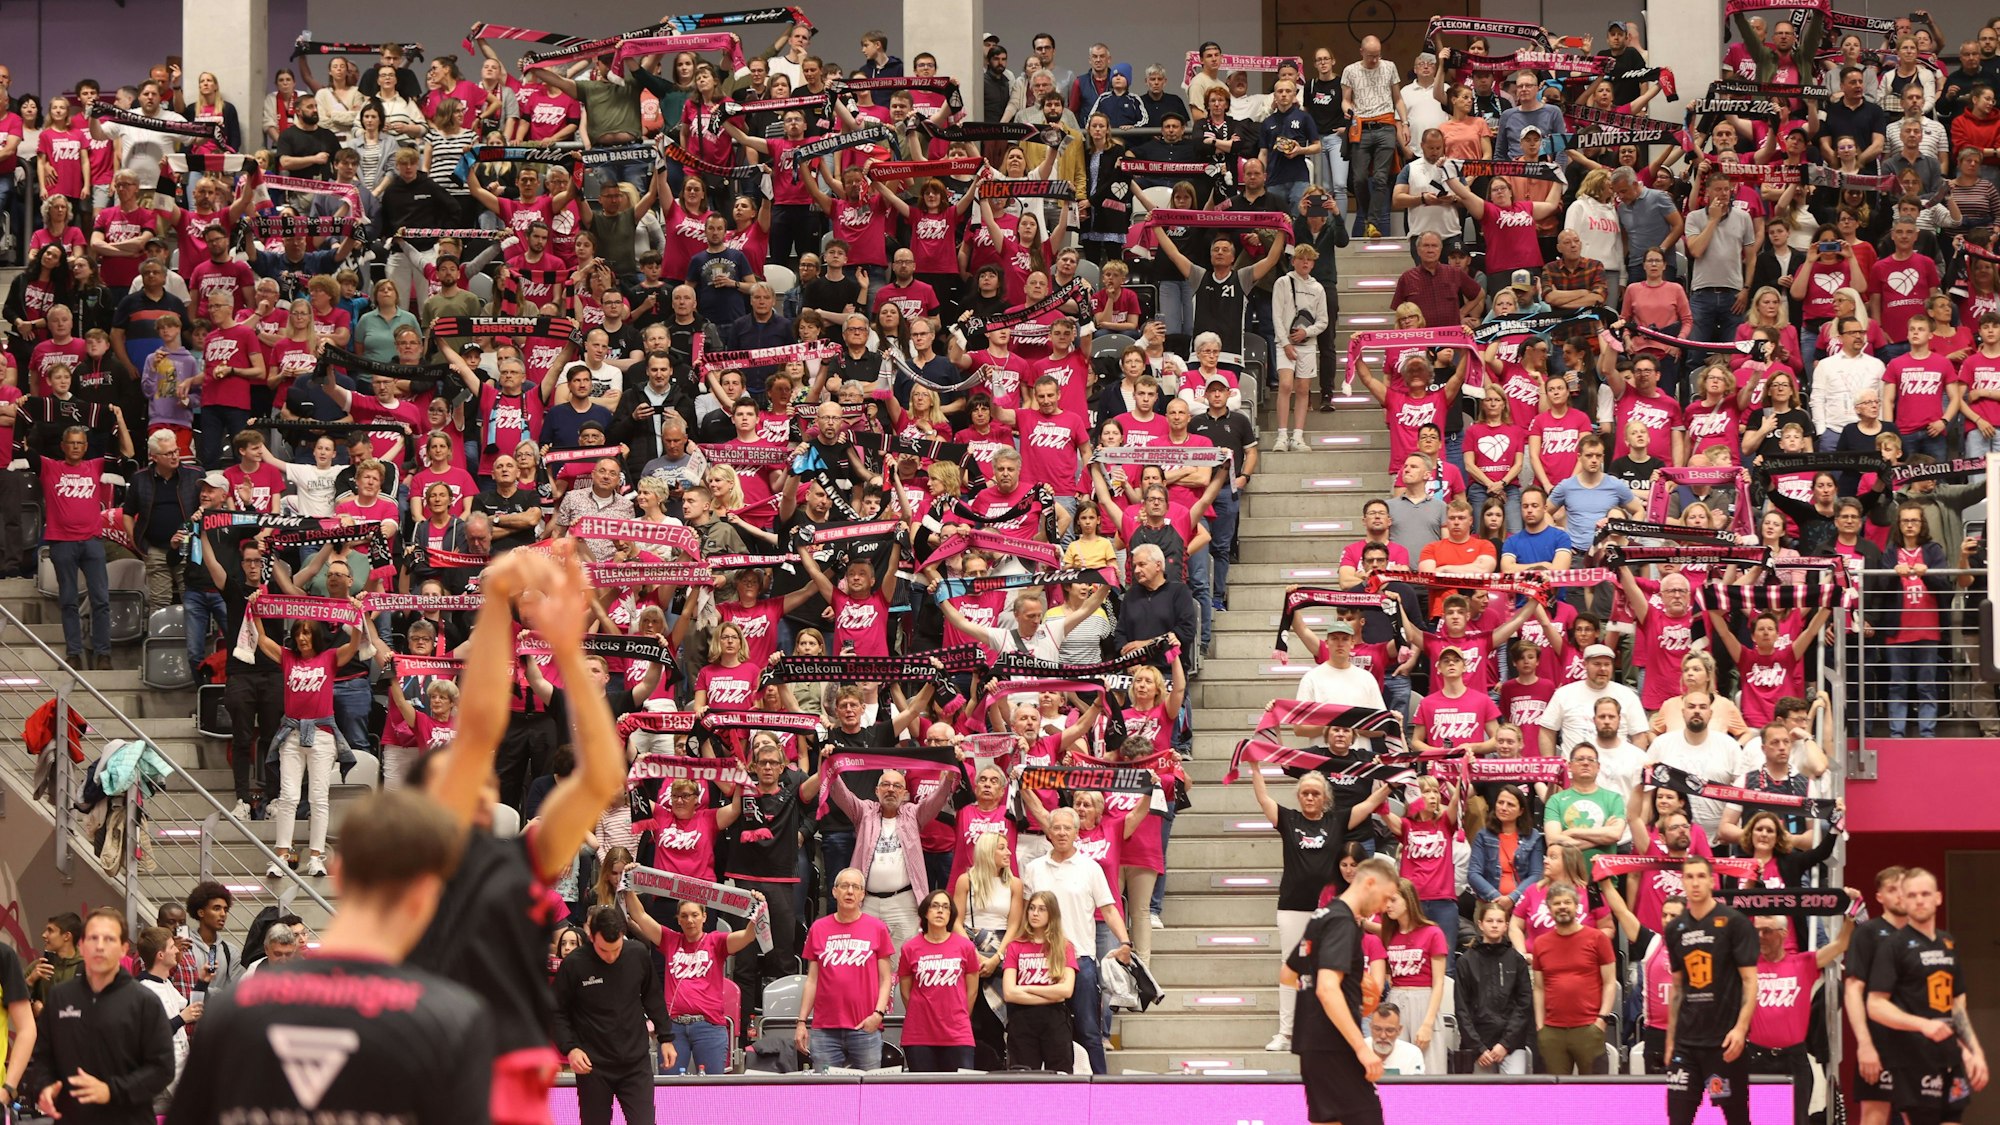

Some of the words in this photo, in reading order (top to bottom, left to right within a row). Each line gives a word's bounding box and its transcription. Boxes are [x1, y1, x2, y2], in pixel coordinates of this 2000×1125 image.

[622, 27, 650, 41] Bonn
[1473, 21, 1515, 34] BASKETS
[1232, 56, 1273, 67] Baskets
[1803, 86, 1829, 97] Bonn
[1695, 99, 1751, 114] PLAYOFFS
[113, 108, 163, 130] Telekom
[839, 127, 880, 145] BASKETS
[1578, 132, 1630, 148] PLAYOFFS
[1632, 129, 1662, 142] 2023
[609, 150, 648, 163] BASKETS
[870, 164, 911, 178] Telekom
[951, 159, 977, 171] Bonn
[1149, 162, 1162, 172] ONE
[287, 216, 331, 229] Baskets
[1195, 212, 1252, 223] Baskets
[261, 227, 310, 237] Playoffs
[316, 226, 342, 237] 2008
[1221, 284, 1236, 298] 21
[471, 316, 538, 326] TELEKOM
[473, 325, 536, 334] BASKETS
[751, 342, 807, 360] BASKETS
[1028, 433, 1071, 451] Wild
[705, 450, 745, 460] TELEKOM
[747, 451, 789, 461] BASKETS
[1147, 452, 1189, 462] BASKETS
[1191, 452, 1217, 462] BONN
[1894, 463, 1951, 482] Telekom
[203, 513, 234, 531] BONN
[581, 516, 700, 552] #HEARTBERG
[1003, 535, 1056, 559] kämpfen
[434, 553, 484, 565] Telekom
[724, 555, 746, 566] TEAM.
[748, 555, 764, 565] ONE
[593, 568, 641, 579] TELEKOM
[643, 567, 690, 578] BASKETS
[972, 577, 1007, 592] BONN
[368, 595, 413, 607] TELEKOM
[415, 594, 461, 606] BASKETS
[1312, 591, 1329, 602] ONE
[285, 603, 330, 618] BASKETS
[330, 607, 358, 623] BONN
[625, 639, 661, 657] Bonn
[402, 657, 450, 670] Telekom
[786, 662, 843, 675] Telekom
[846, 662, 901, 674] Baskets
[901, 663, 937, 676] Bonn
[1008, 654, 1060, 670] Telekom
[707, 688, 752, 706] Wild
[718, 713, 743, 725] TEAM.
[746, 713, 763, 725] ONE
[1430, 721, 1479, 740] Wild
[845, 757, 865, 768] Bonn
[1481, 762, 1503, 775] EEN
[1504, 762, 1541, 775] MOOIE
[691, 767, 715, 779] TO
[1022, 767, 1067, 791] HÜCK
[1067, 768, 1113, 791] ODER
[1113, 767, 1144, 789] NIE
[721, 890, 750, 908] BONN
[1800, 894, 1838, 909] 2010
[826, 940, 849, 952] BONN
[819, 948, 875, 968] Wild
[917, 960, 941, 972] BONN
[918, 968, 963, 987] Wild
